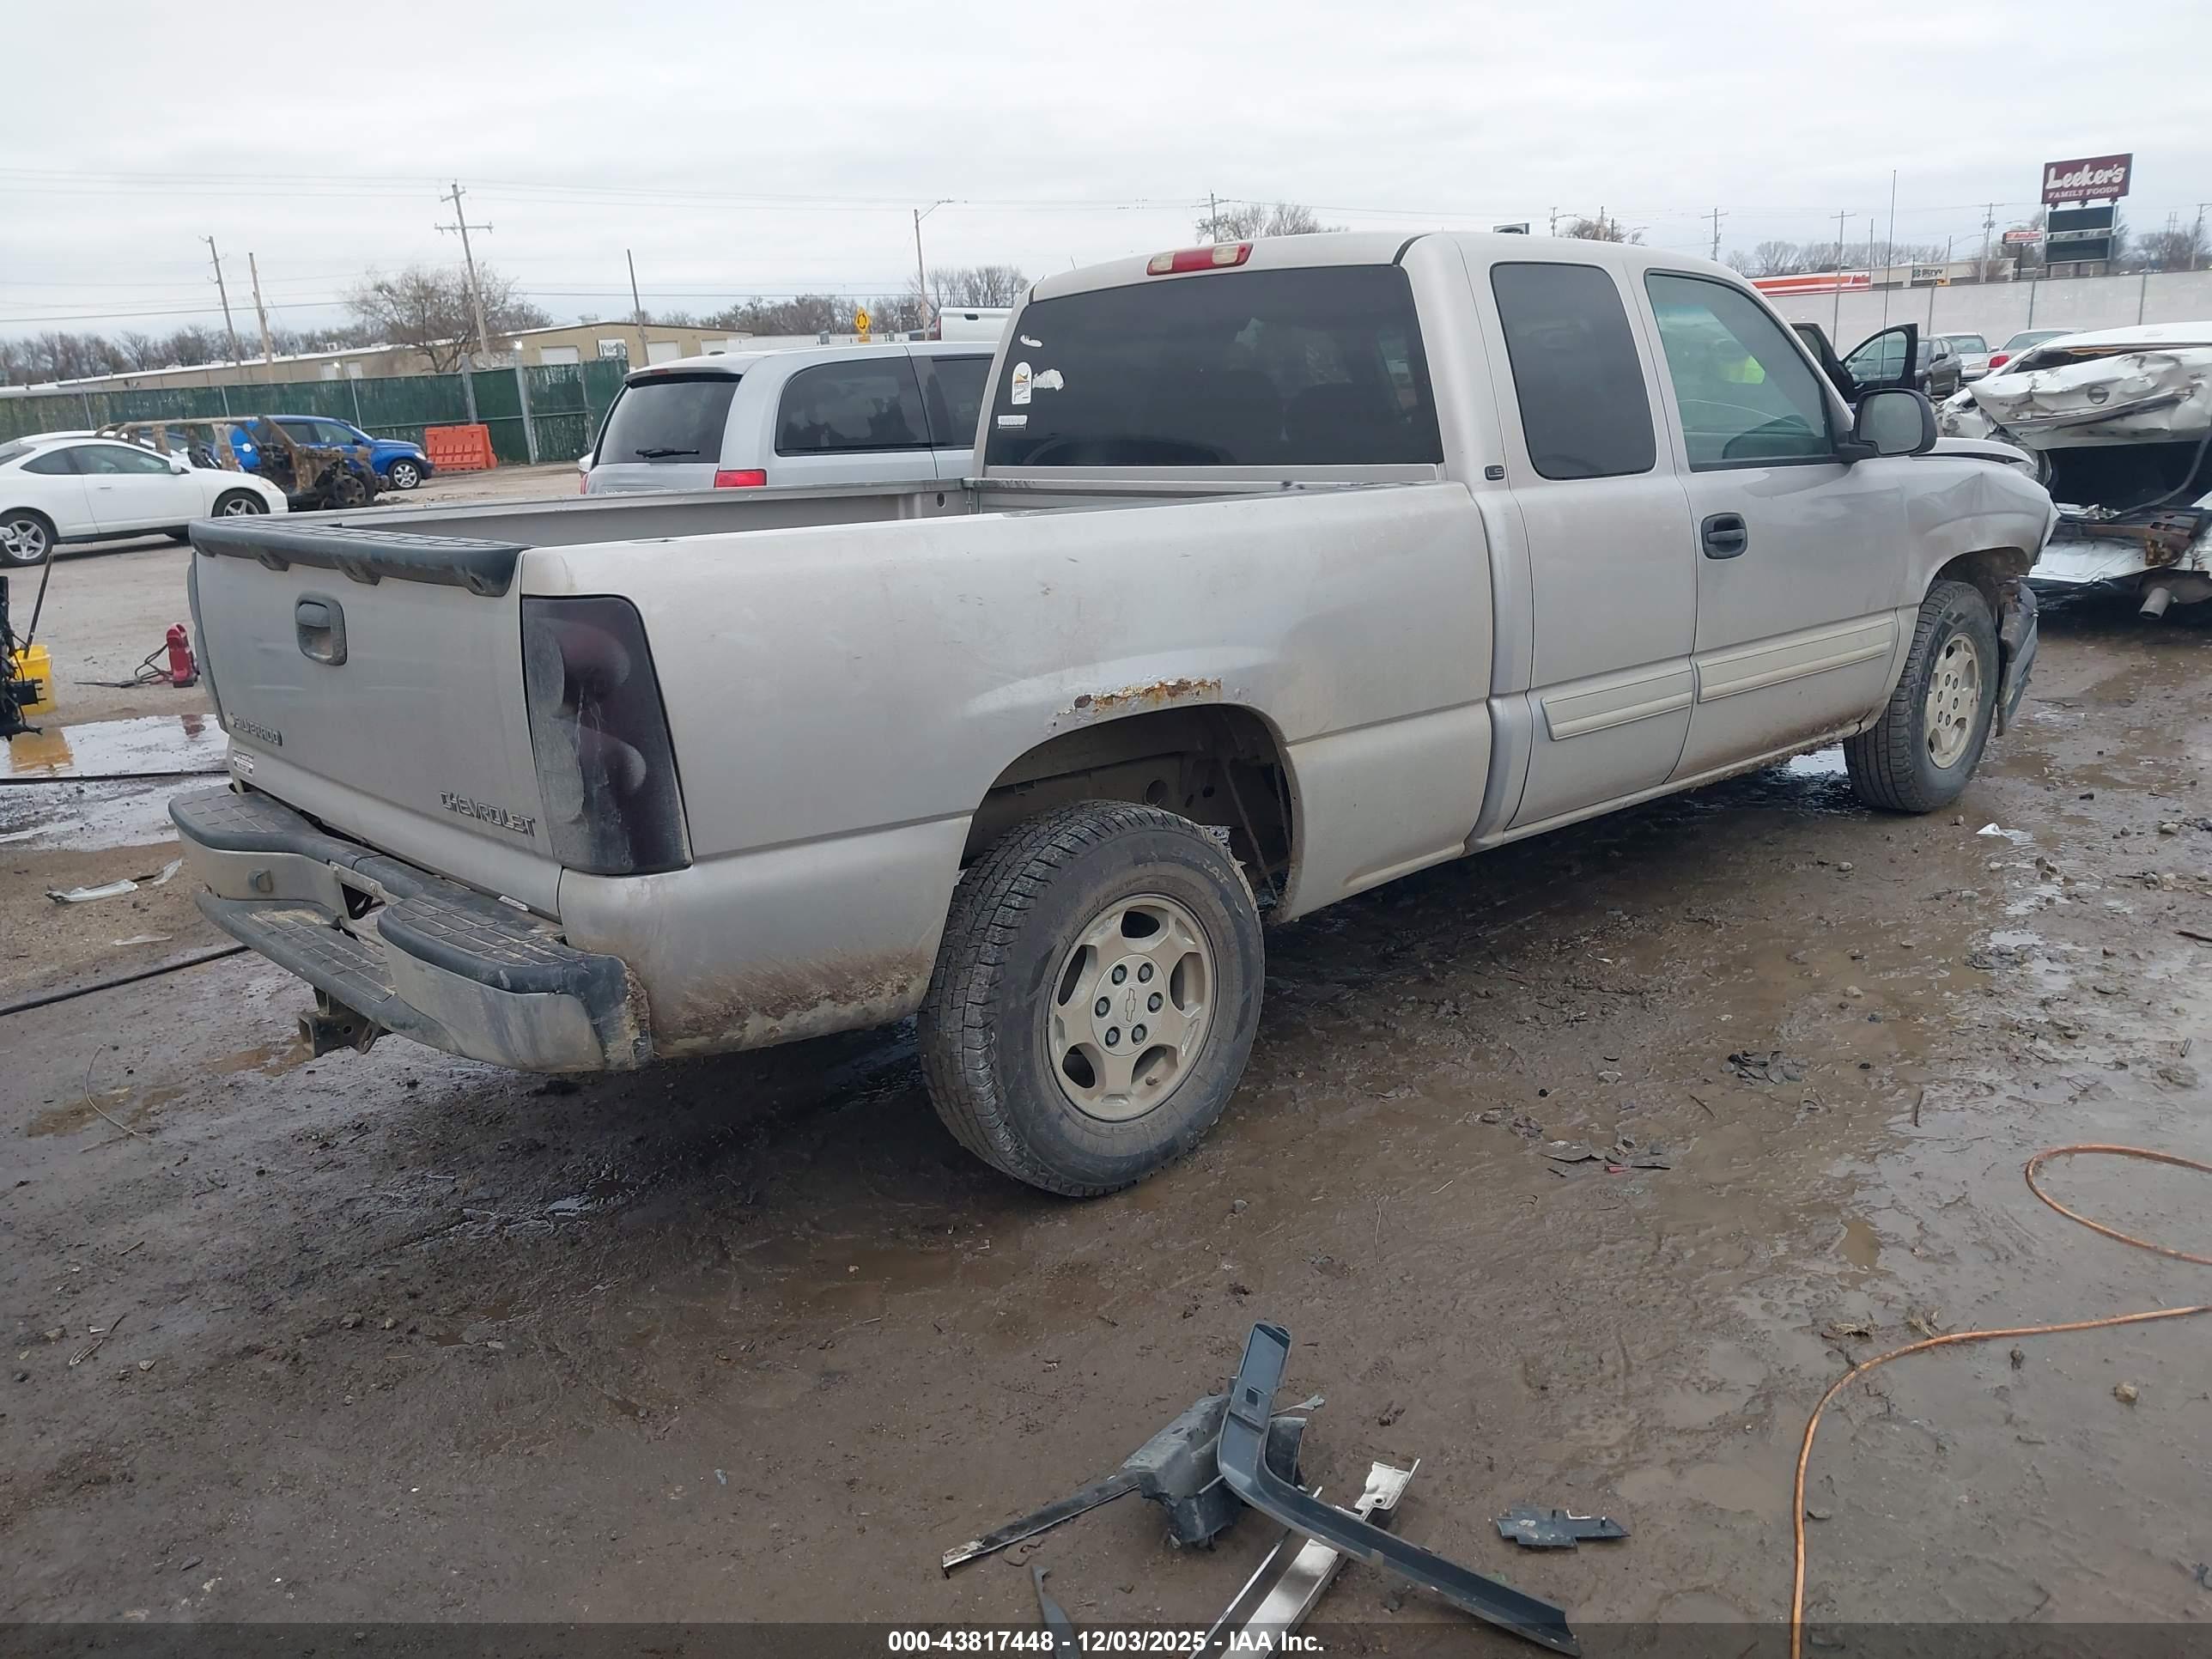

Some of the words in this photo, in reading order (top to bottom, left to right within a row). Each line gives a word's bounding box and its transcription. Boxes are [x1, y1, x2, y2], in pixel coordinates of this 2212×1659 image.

[2045, 163, 2126, 189] Leeker's
[2048, 189, 2085, 199] FAMILY
[2086, 185, 2119, 197] FOODS
[1486, 467, 1504, 477] LS
[440, 790, 536, 837] CHEVROLET
